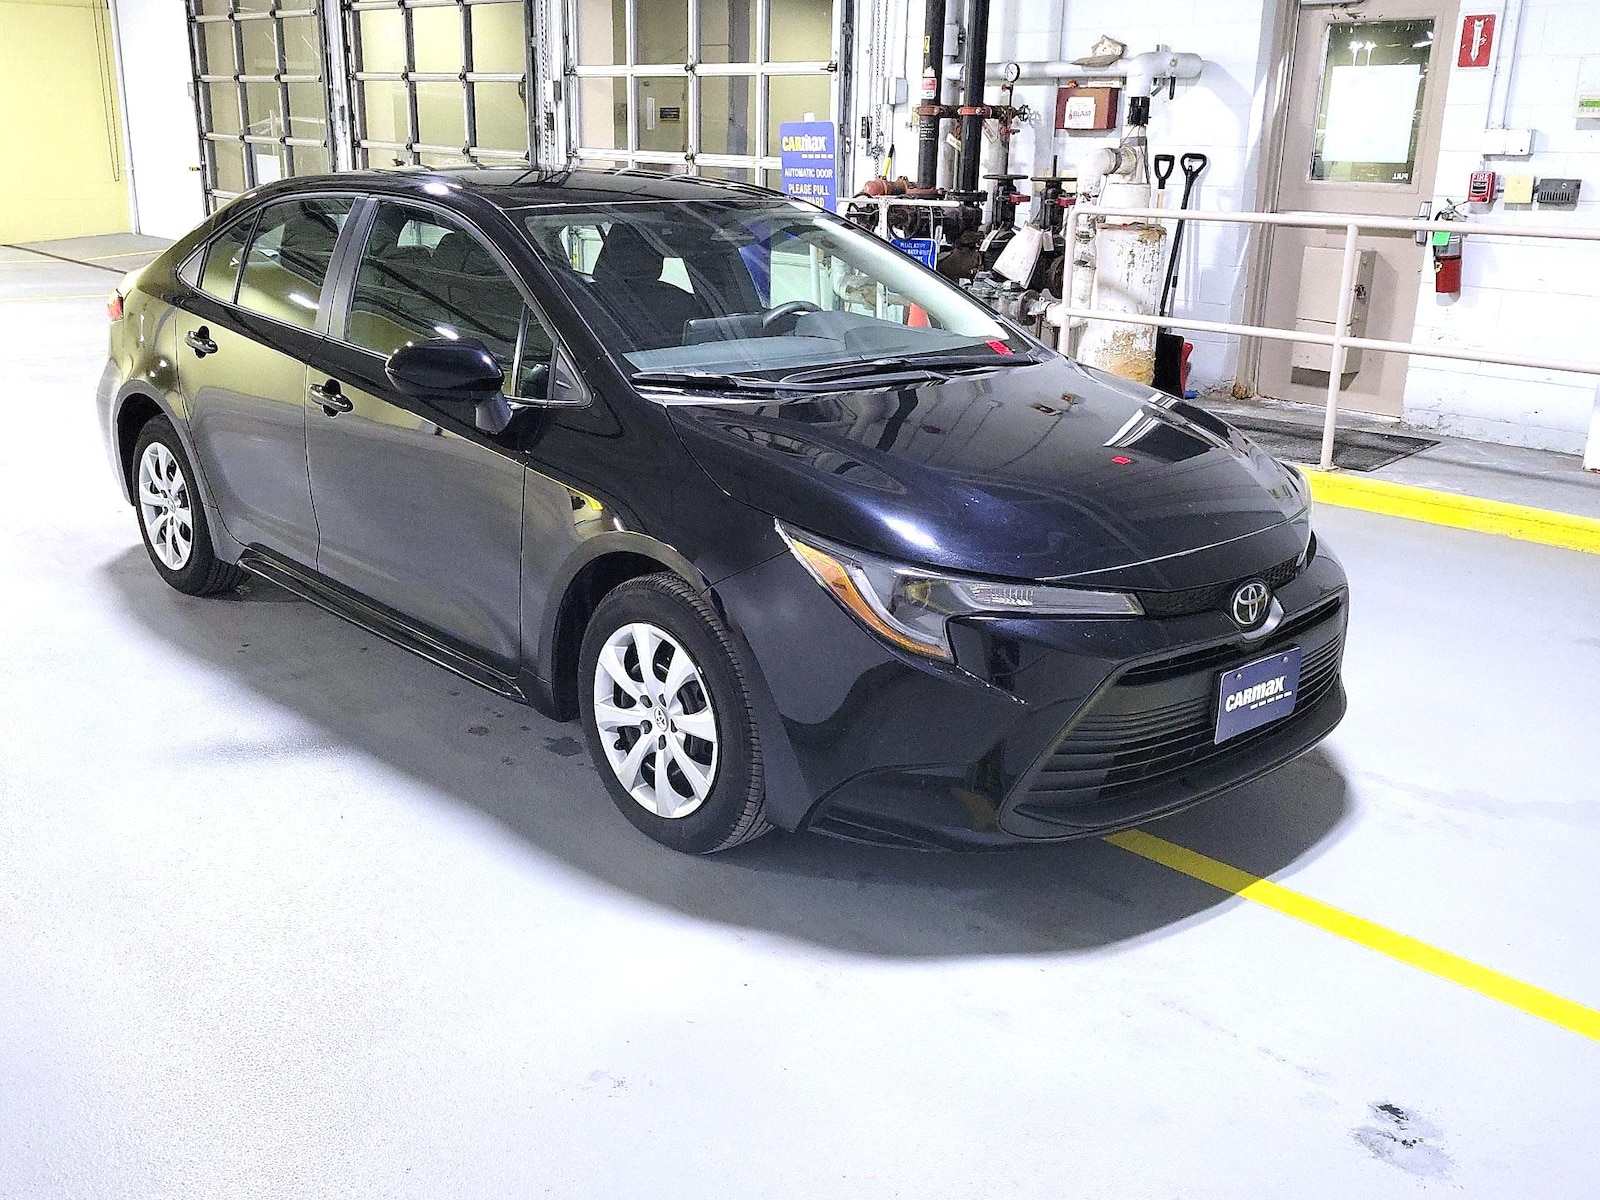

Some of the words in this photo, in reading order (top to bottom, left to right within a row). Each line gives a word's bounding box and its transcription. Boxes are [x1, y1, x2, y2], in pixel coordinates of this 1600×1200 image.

[784, 168, 815, 177] AUTOMATIC
[815, 169, 834, 179] DOOR
[1472, 173, 1489, 181] FIRE
[788, 184, 812, 195] PLEASE
[813, 185, 830, 196] PULL
